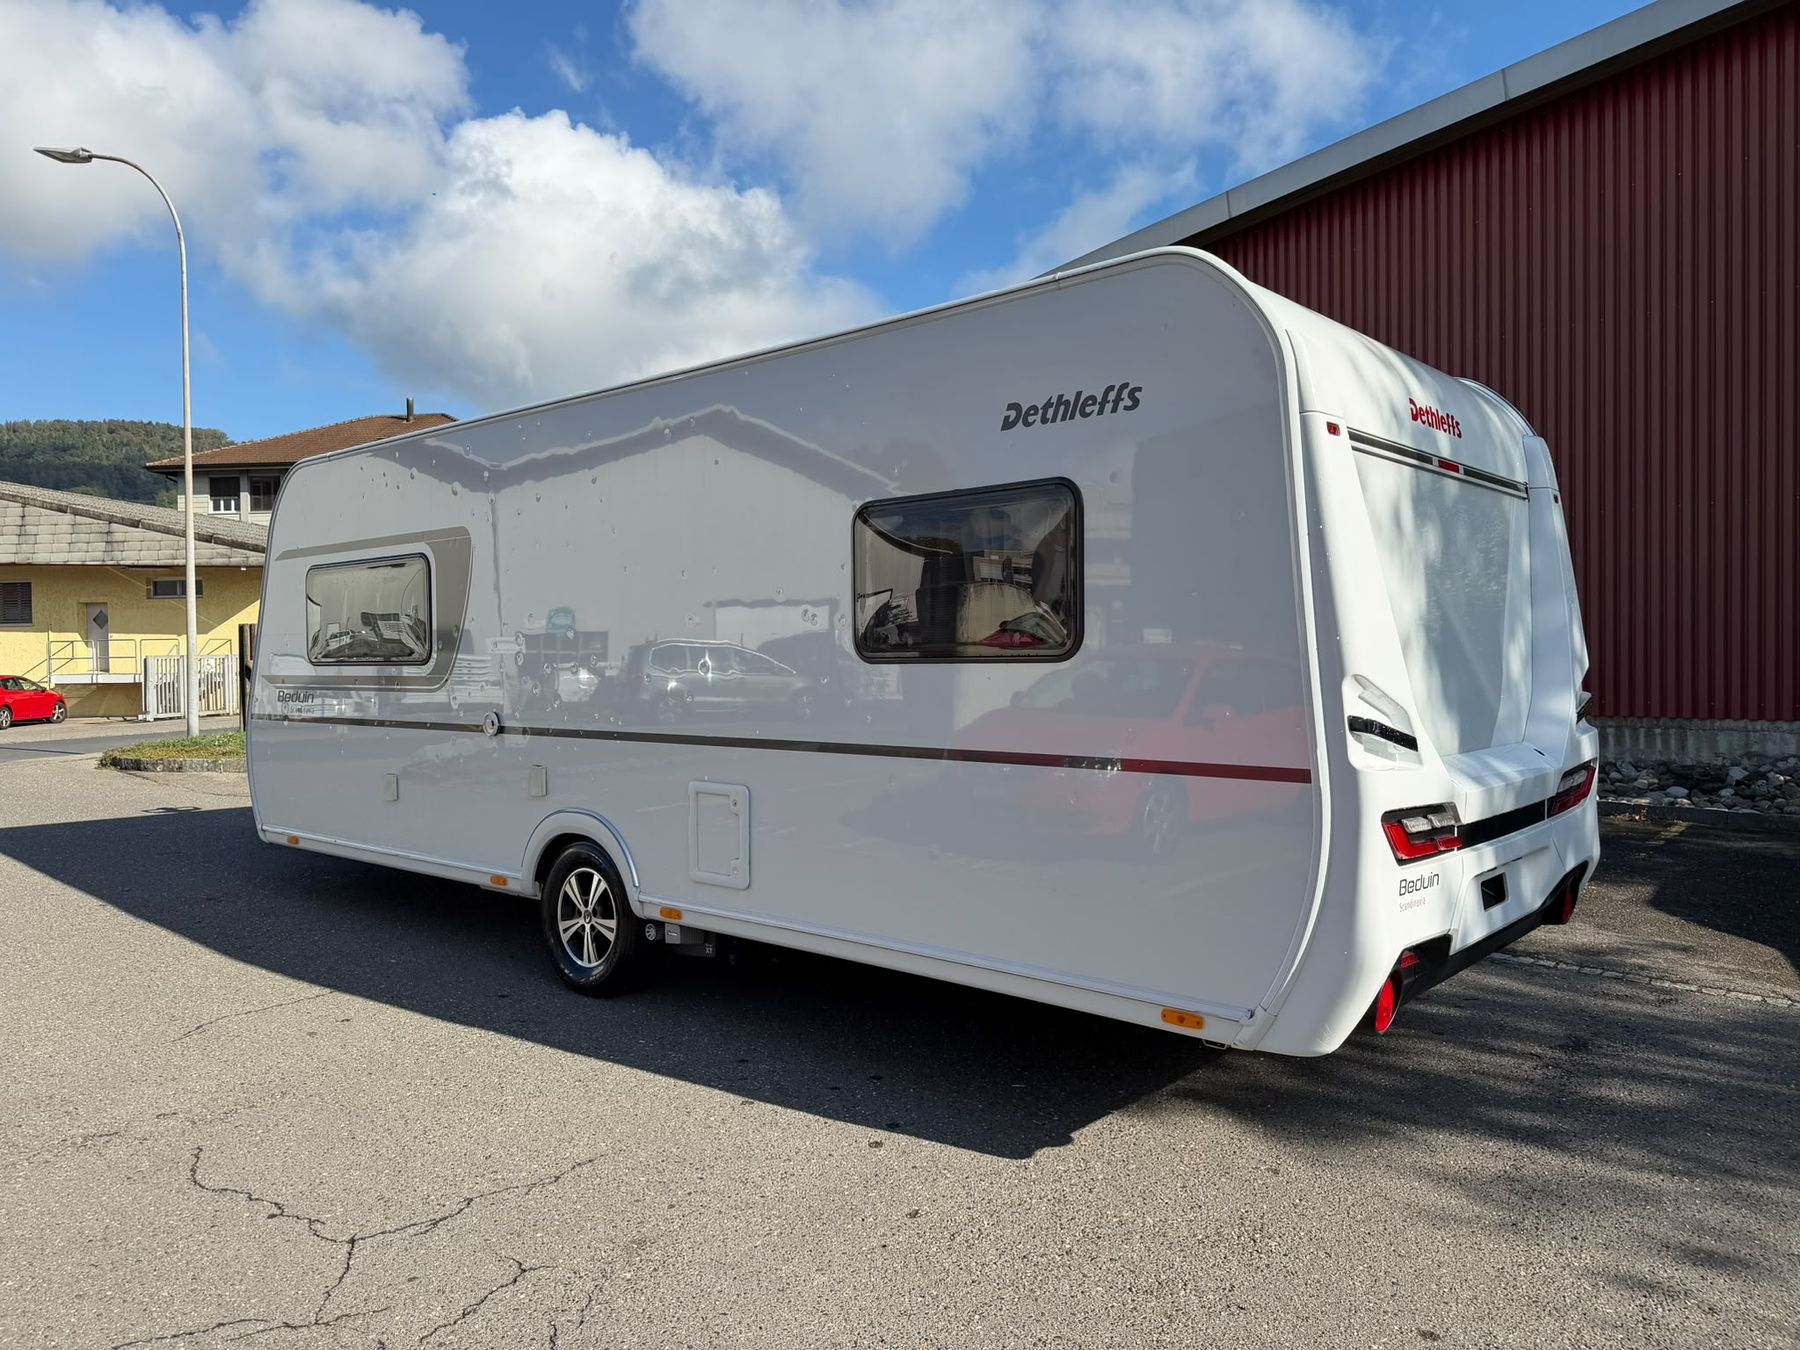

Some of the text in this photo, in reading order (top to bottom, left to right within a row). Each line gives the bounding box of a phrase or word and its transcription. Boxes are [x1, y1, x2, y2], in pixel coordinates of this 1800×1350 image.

[1000, 382, 1143, 431] Dethleffs
[1409, 398, 1462, 439] Dethleffs
[277, 690, 314, 703] Beduin
[1399, 872, 1439, 896] Beduin
